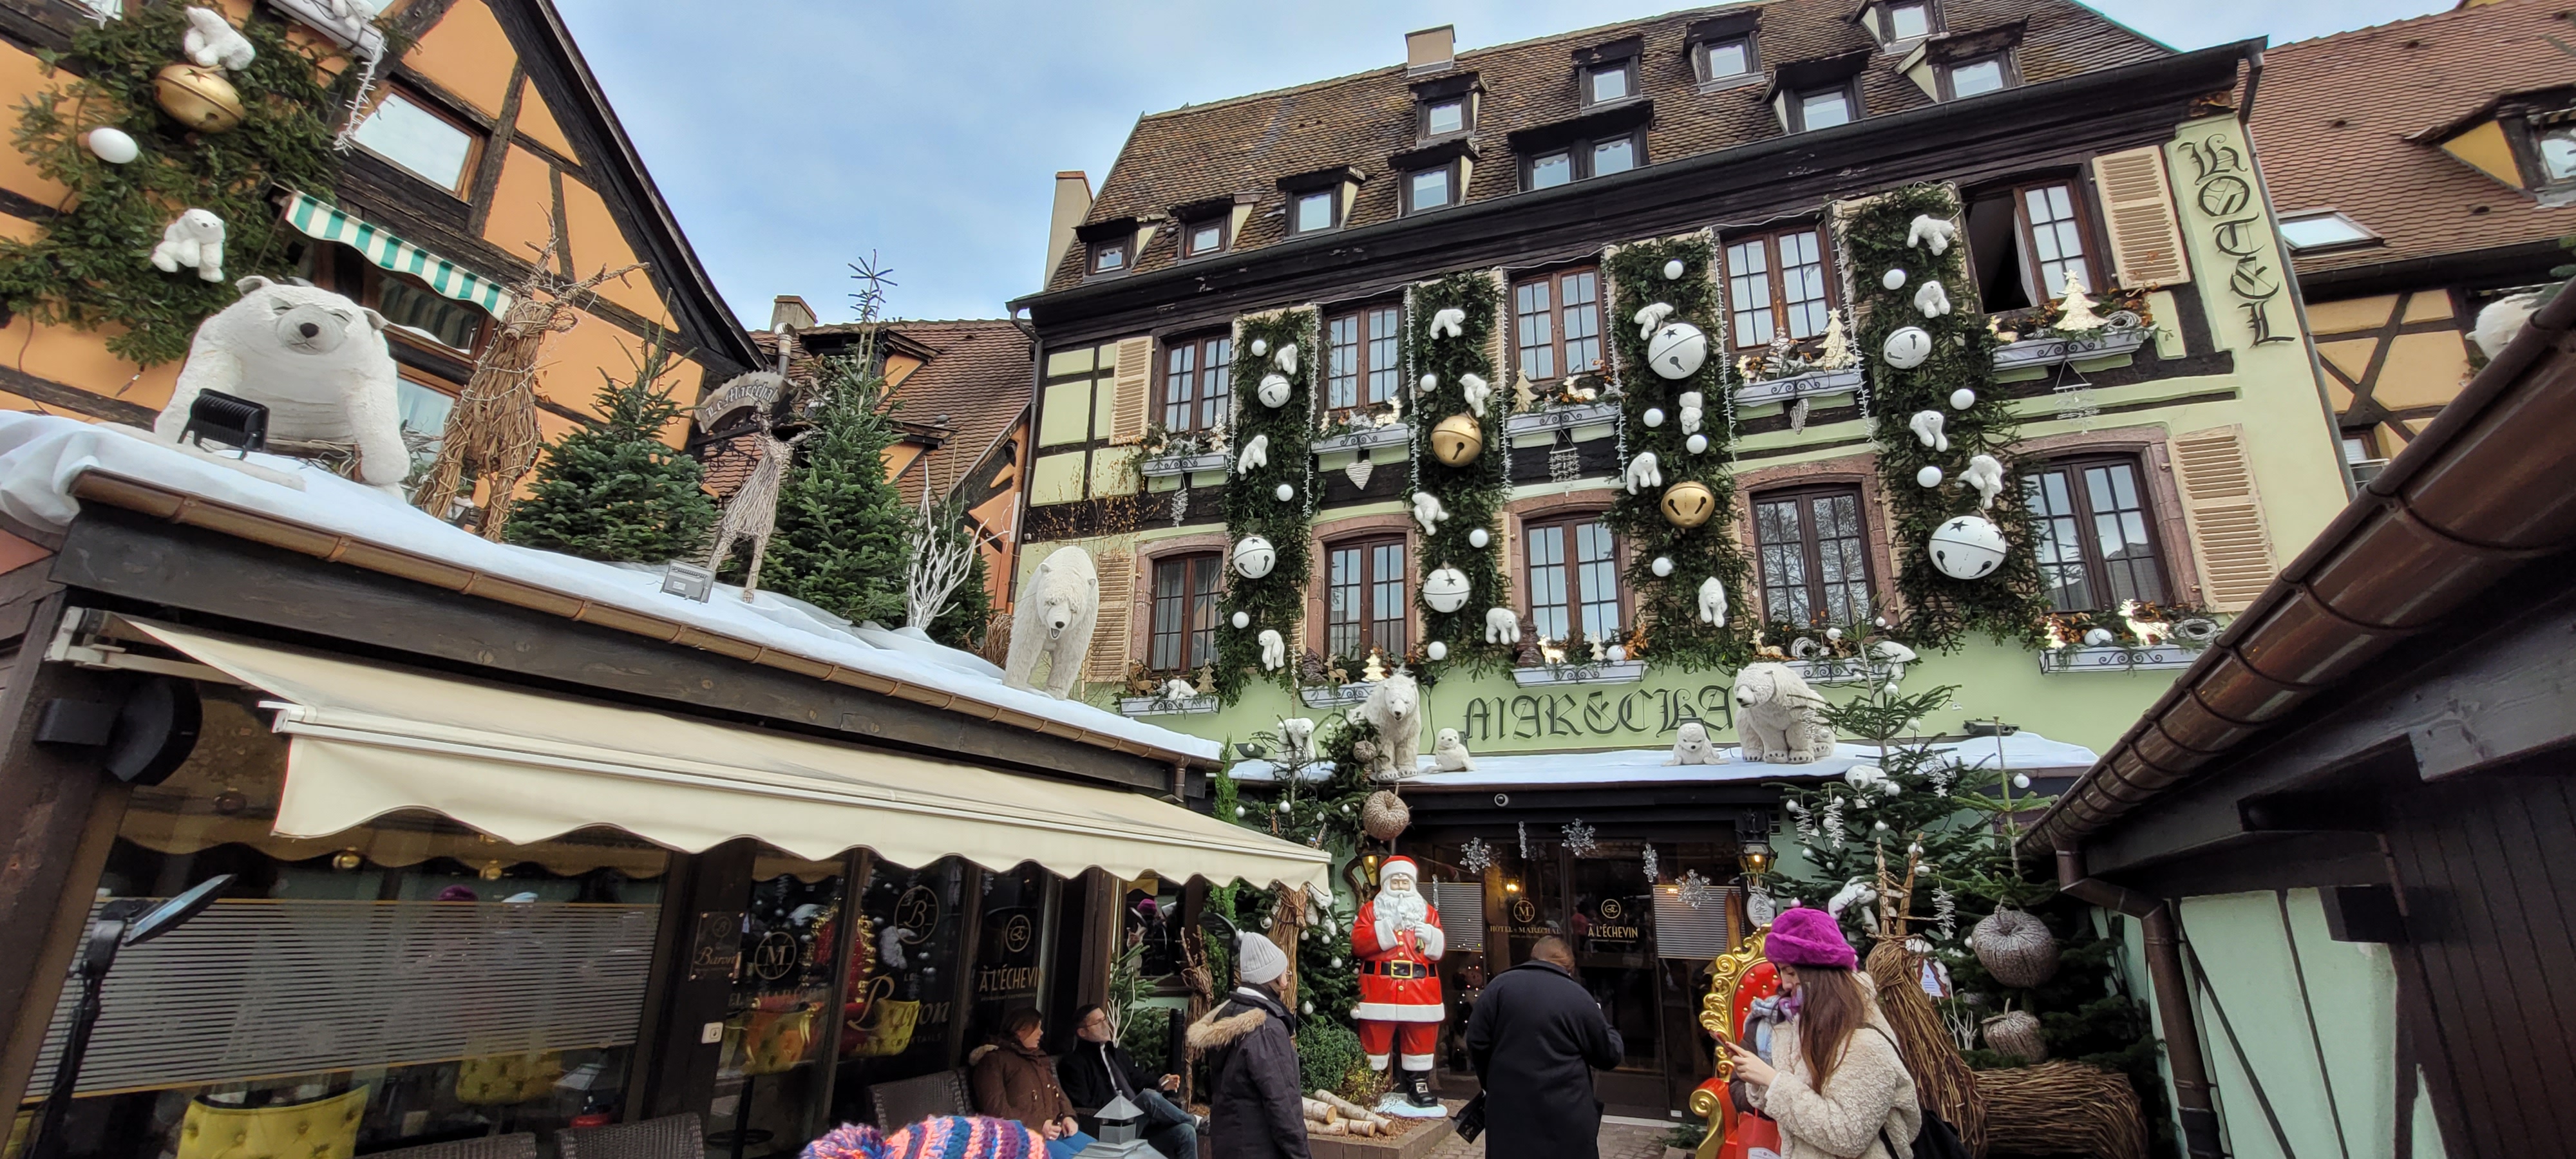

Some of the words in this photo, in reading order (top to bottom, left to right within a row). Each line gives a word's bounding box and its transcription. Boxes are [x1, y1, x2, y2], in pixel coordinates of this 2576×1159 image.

[2177, 133, 2296, 349] HOTEL
[706, 400, 723, 420] Le
[1462, 684, 1734, 742] MARECHA
[1490, 924, 1513, 933] HÔTEL
[1518, 925, 1561, 934] MARÉCHAL
[1587, 923, 1595, 937] À
[1596, 923, 1639, 938] L'ÉCHEVIN
[694, 945, 736, 965] Baron
[847, 972, 951, 1032] Baron
